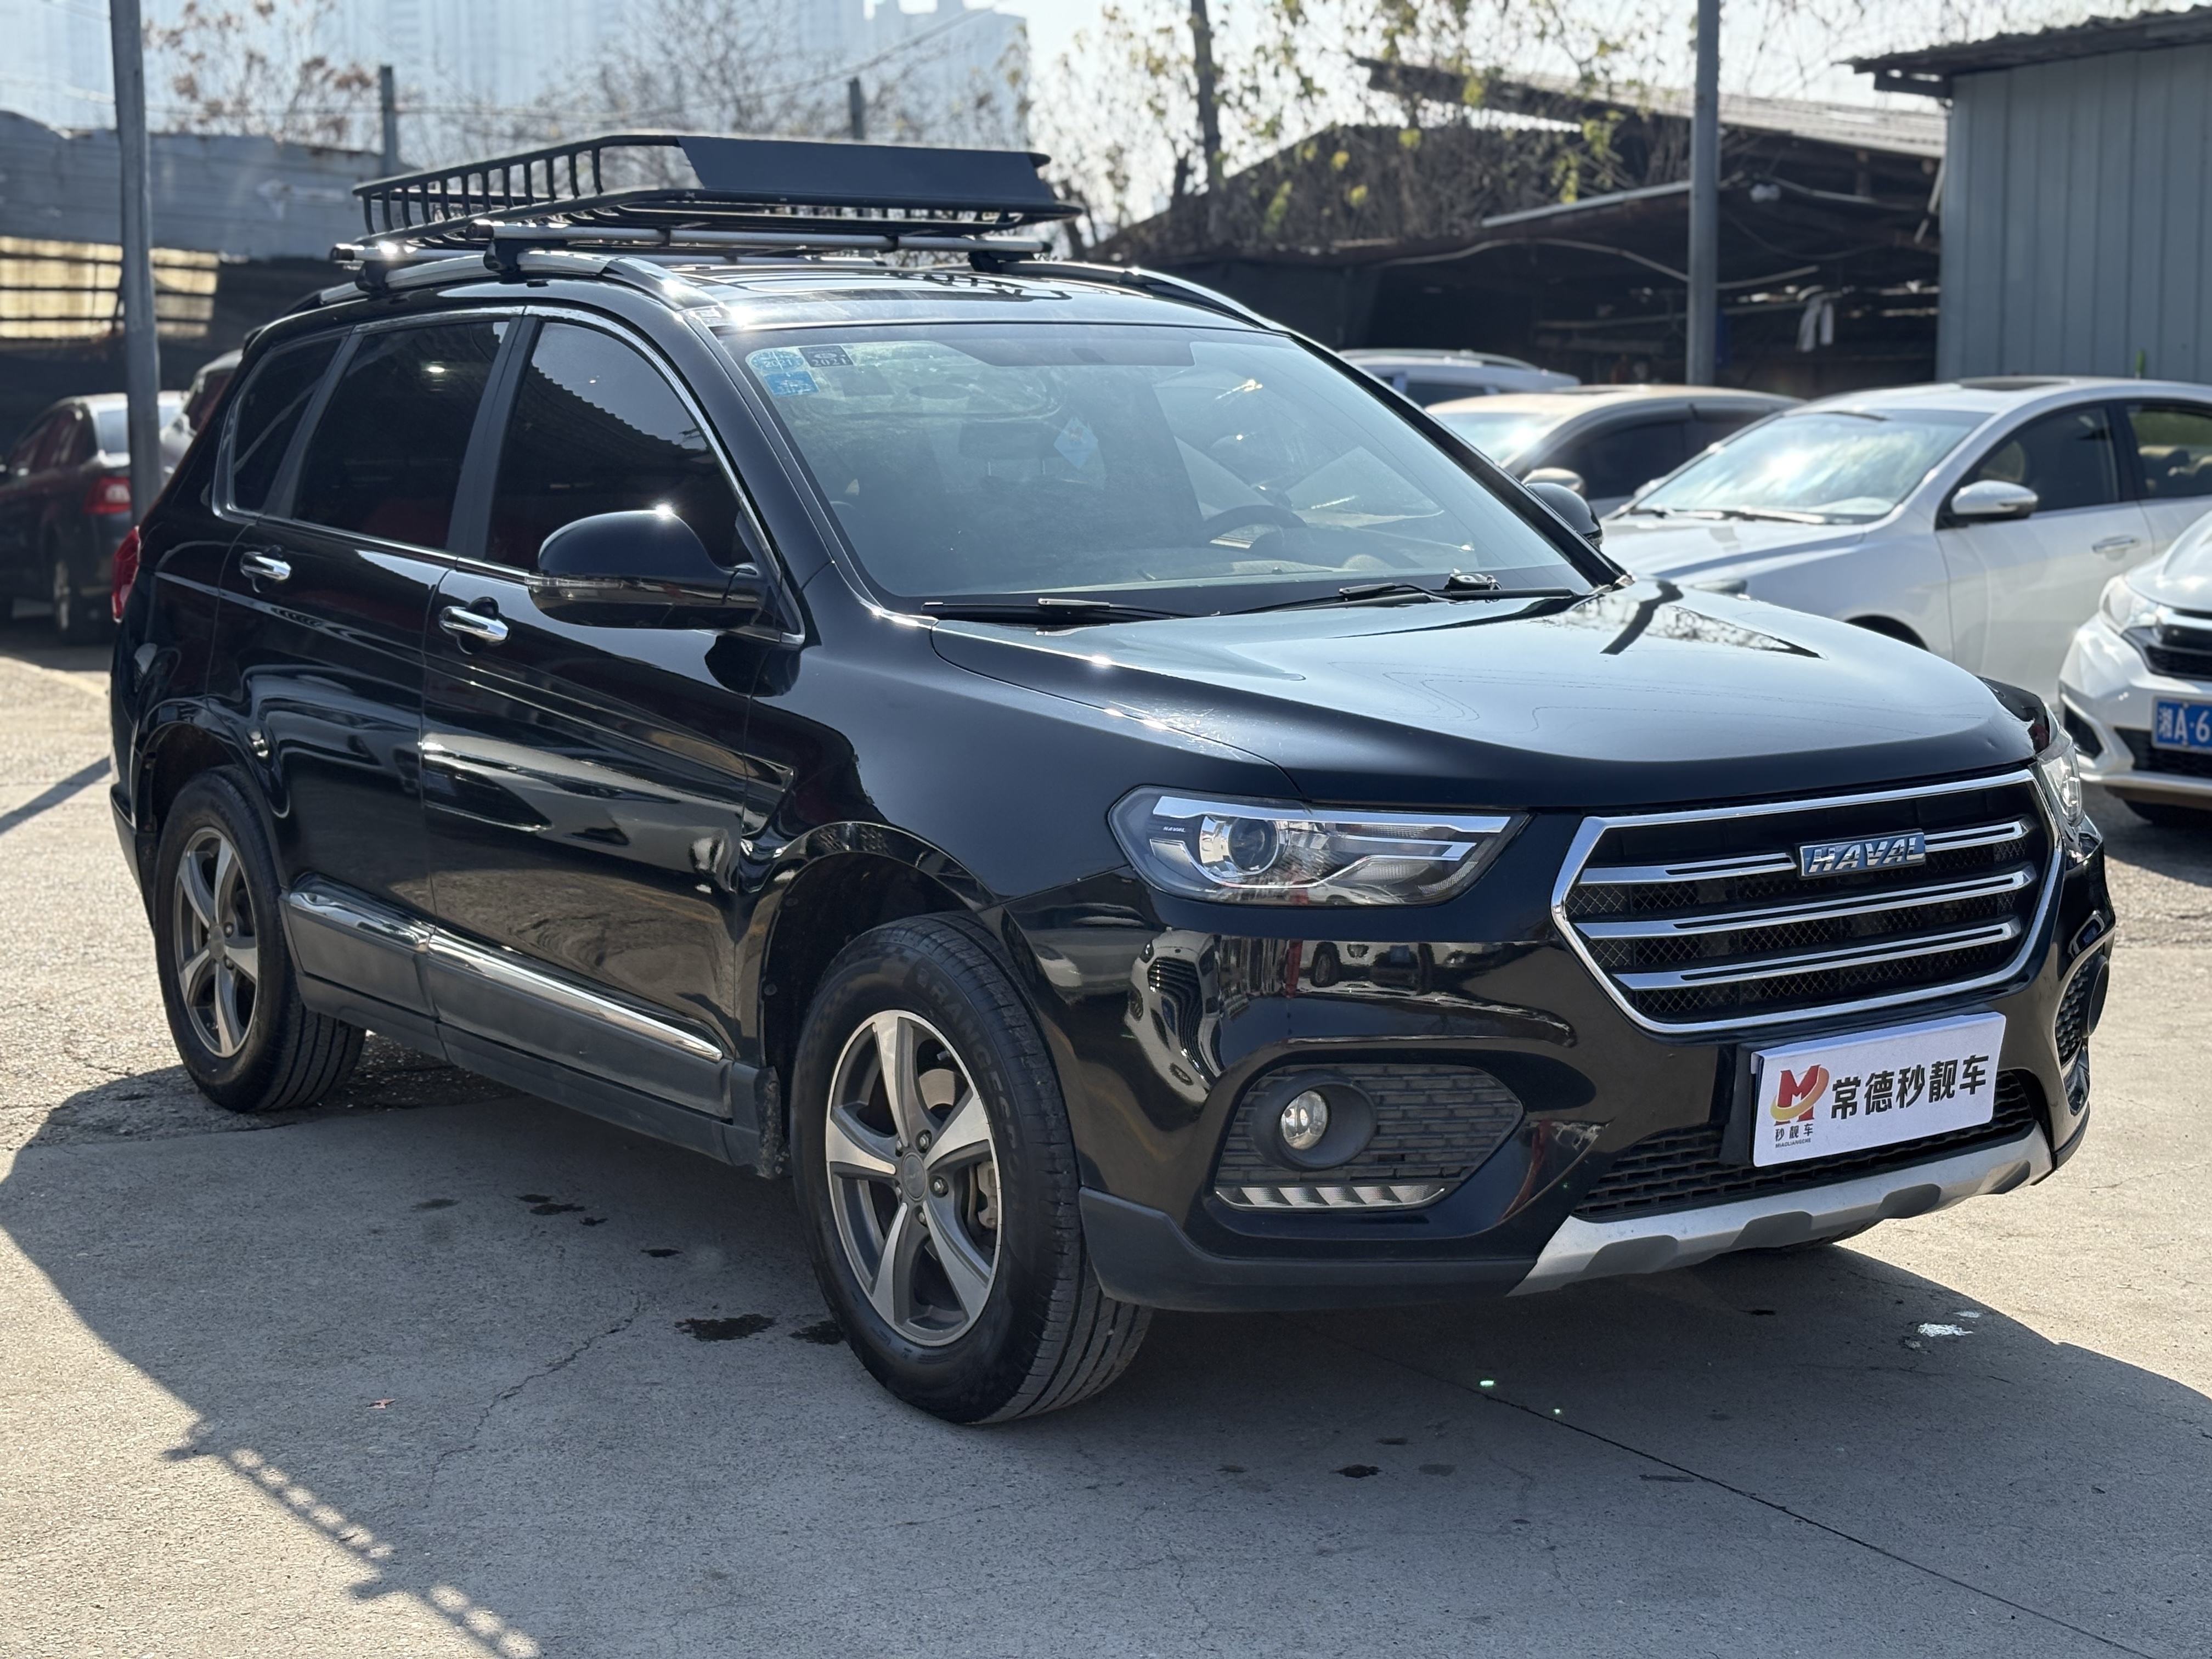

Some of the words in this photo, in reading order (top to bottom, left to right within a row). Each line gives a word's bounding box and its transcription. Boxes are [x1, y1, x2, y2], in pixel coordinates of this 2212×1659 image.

[811, 358, 847, 366] 2021
[1808, 837, 1925, 873] HAVAL
[1831, 1054, 1989, 1120] 常德秒靓车
[1775, 1123, 1814, 1142] 秒靓车
[1775, 1137, 1811, 1148] MIAOLIANGCHE
